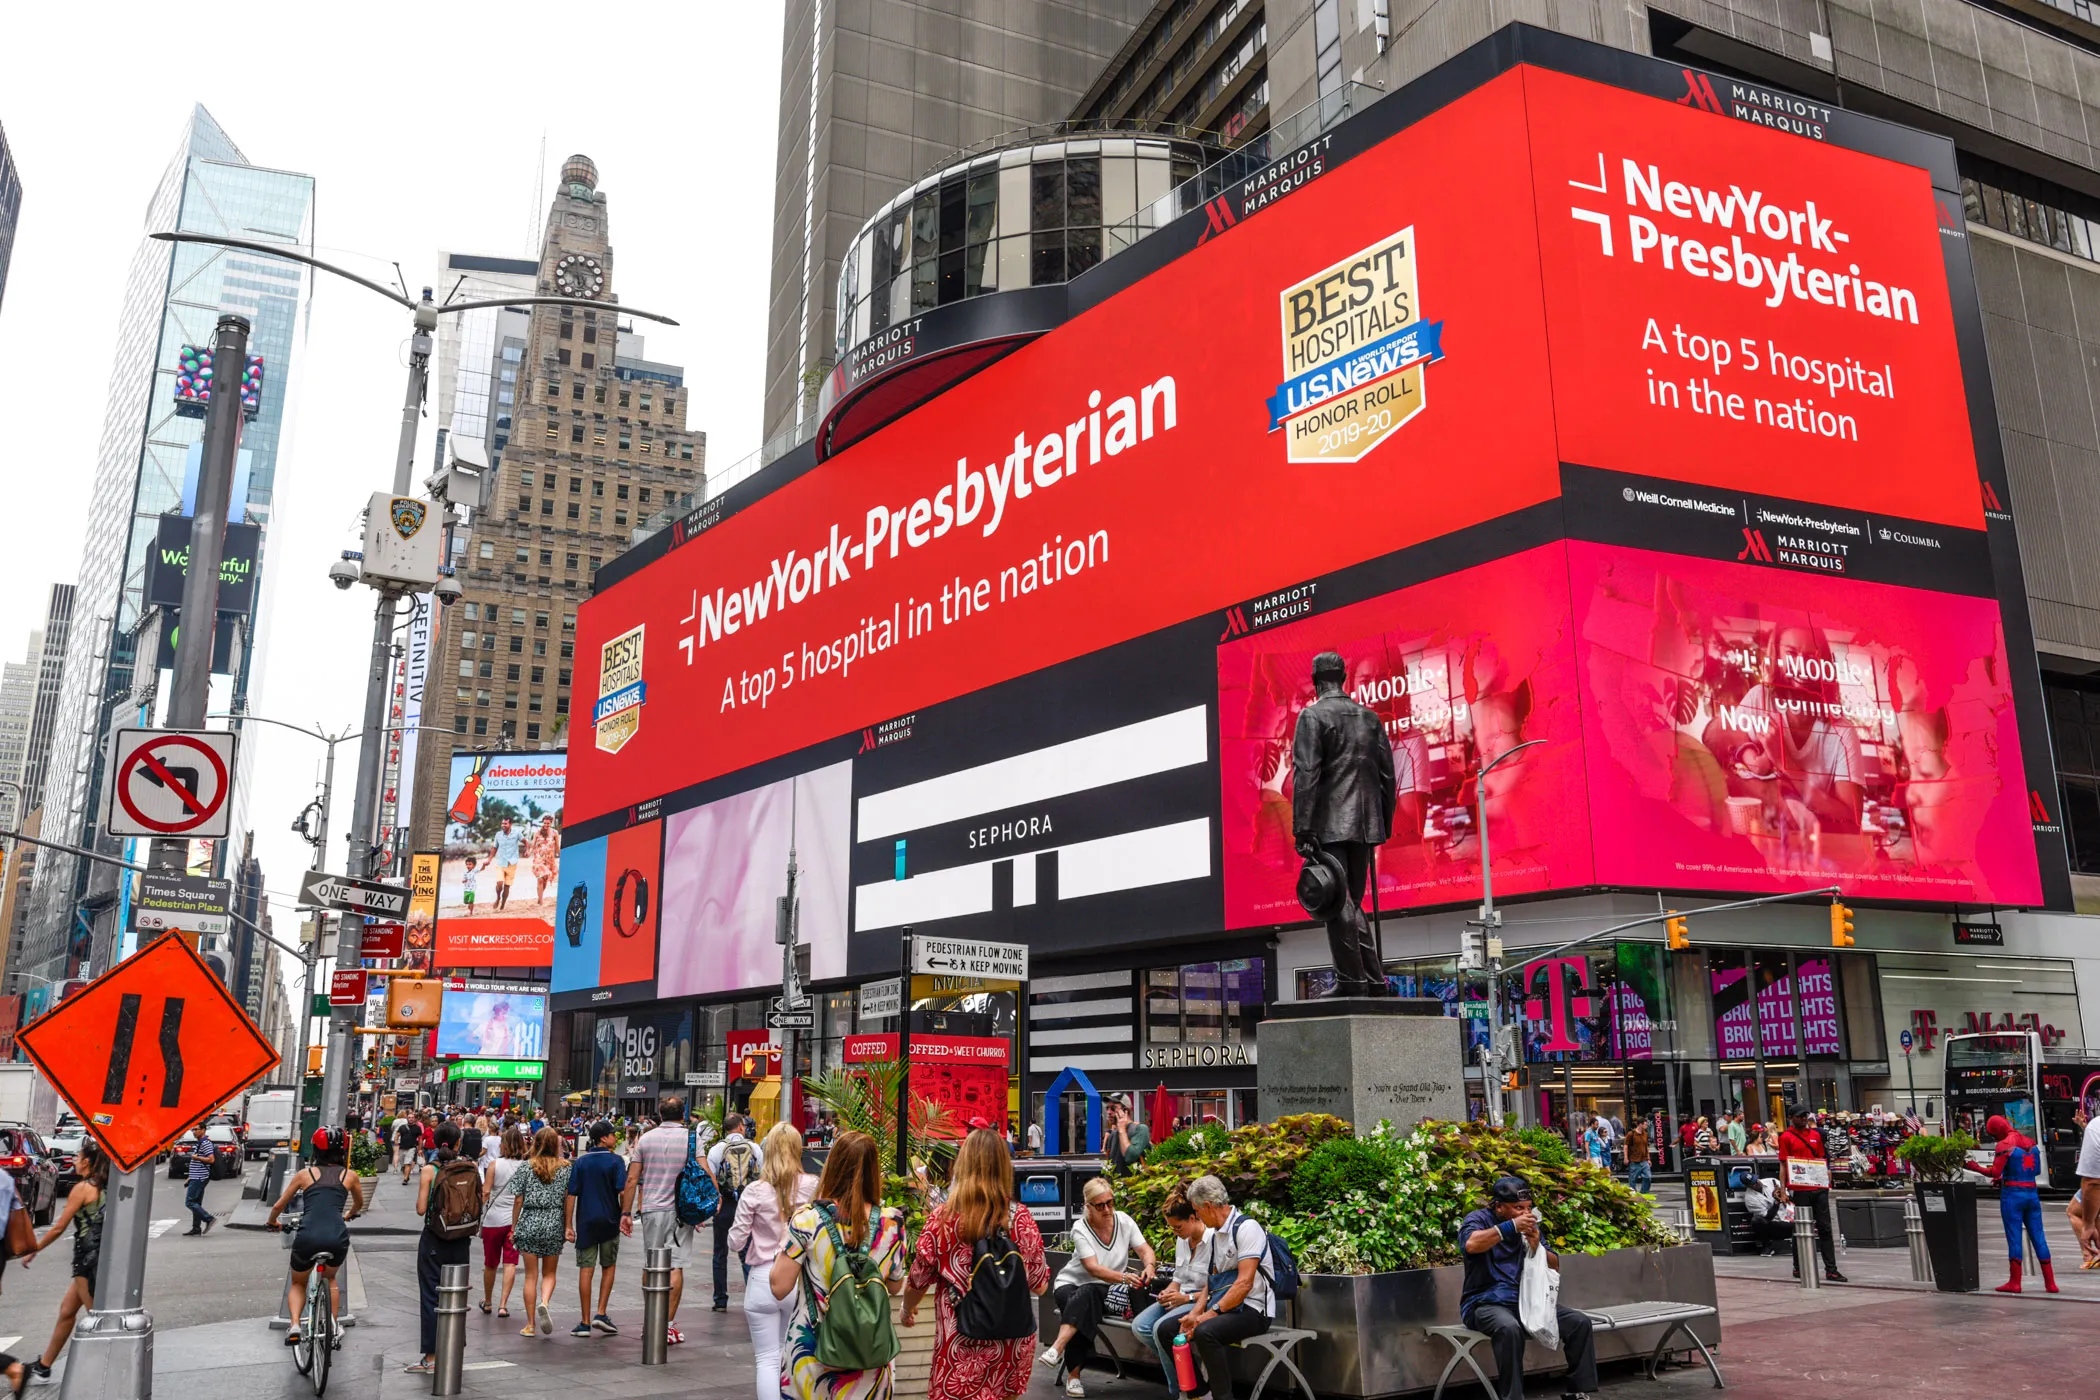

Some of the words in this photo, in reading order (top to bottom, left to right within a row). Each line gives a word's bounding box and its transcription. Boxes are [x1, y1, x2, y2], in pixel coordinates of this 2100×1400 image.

[1731, 84, 1832, 123] MARRIOTT
[1734, 104, 1824, 140] MARQUIS
[1244, 134, 1333, 197] MARRIOTT
[1244, 160, 1323, 215] MARQUIS
[1628, 213, 1920, 326] Presbyterian
[1289, 241, 1406, 339] BEST
[852, 318, 923, 365] MARRIOTT
[1291, 292, 1410, 373] HOSPITALS
[1358, 345, 1386, 364] WORLD
[1386, 331, 1418, 351] REPORT
[851, 341, 912, 383] MARQUIS
[1642, 318, 1669, 355] A
[1672, 323, 1732, 376] top
[1740, 338, 1760, 372] 5
[1768, 340, 1894, 400] hospital
[1296, 398, 1360, 440] HONOR
[1363, 378, 1413, 411] ROLL
[1646, 368, 1680, 410] in
[1686, 378, 1746, 421] the
[1753, 398, 1859, 442] nation
[1317, 408, 1392, 455] 2019-20
[688, 495, 726, 525] MARRIOTT
[699, 375, 1178, 648] NewYork-Presbyterian
[1635, 490, 1660, 504] Weill
[1659, 494, 1693, 510] Cornell
[1693, 499, 1736, 516] Medicine
[687, 511, 720, 538] MARQUIS
[1762, 510, 1861, 537] NewYork-Presbyterian
[1778, 535, 1849, 557] MARRIOTT
[1893, 532, 1941, 549] COLUMBIA
[162, 549, 250, 573] Worful
[343, 550, 363, 560] NYPD
[1779, 551, 1844, 571] MARQUIS
[438, 565, 456, 575] NYPD
[1253, 583, 1317, 613] MARRIOTT
[719, 677, 736, 714] A
[740, 667, 776, 709] top
[782, 651, 795, 689] 5
[801, 602, 900, 678] hospital
[908, 597, 932, 640] in
[939, 577, 991, 626] the
[999, 529, 1109, 604] nation
[1253, 600, 1311, 627] MARQUIS
[409, 602, 429, 703] REFINITIV
[603, 631, 642, 674] BEST
[601, 660, 640, 695] HOSPITALS
[599, 717, 620, 735] HONOR
[620, 710, 635, 727] ROLL
[878, 714, 916, 734] MARRIOTT
[1720, 704, 1770, 734] Now
[878, 728, 911, 745] MARQUIS
[487, 778, 520, 787] HOTELS
[533, 778, 566, 786] RESORT
[638, 798, 663, 812] MARRIOTT
[638, 808, 659, 821] MARQUIS
[969, 814, 1054, 849] SEPHORA
[418, 865, 431, 873] THE
[1675, 862, 1685, 870] We
[1723, 865, 1753, 874] Americans
[415, 873, 433, 884] LION
[145, 885, 176, 897] Times
[178, 888, 216, 900] Square
[318, 884, 350, 901] ONE
[364, 891, 397, 908] WAY
[412, 884, 434, 897] KING
[143, 897, 196, 910] Pedestrian
[197, 902, 224, 912] Plaza
[448, 934, 469, 944] VISIT
[926, 941, 977, 957] PEDESTRIAN
[979, 946, 1001, 958] FLOW
[1002, 948, 1023, 961] ZONE
[333, 973, 340, 981] NO
[340, 973, 359, 981] STANDING
[970, 960, 991, 973] KEEP
[992, 962, 1023, 975] MOVING
[333, 982, 349, 990] Anytime
[591, 990, 610, 1001] swatch
[862, 986, 880, 999] PEDESTRIAN
[890, 983, 899, 995] ZONE
[877, 1001, 886, 1012] KEEP
[886, 998, 899, 1010] MOVING
[1467, 1009, 1473, 1017] W
[1475, 1009, 1483, 1018] 46
[793, 1016, 808, 1024] WAY
[625, 1025, 656, 1058] BIG
[908, 1044, 949, 1056] OFFEED
[953, 1046, 975, 1057] SWEET
[976, 1047, 1006, 1058] CHURROS
[1145, 1044, 1249, 1069] SEPHORA
[471, 1065, 500, 1075] YORK
[515, 1066, 539, 1075] LINE
[624, 1057, 654, 1077] BOLD
[626, 1085, 645, 1094] swatch
[1373, 1083, 1391, 1095] You're
[1392, 1084, 1398, 1092] a
[1398, 1083, 1418, 1094] Grand
[1420, 1082, 1431, 1092] Old
[1432, 1081, 1445, 1094] Flag
[2043, 1074, 2059, 1087] BIG
[1965, 1087, 2012, 1095] BIGBUSTOURS.COM
[1657, 1137, 1664, 1147] TO
[1658, 1147, 1666, 1165] BACK
